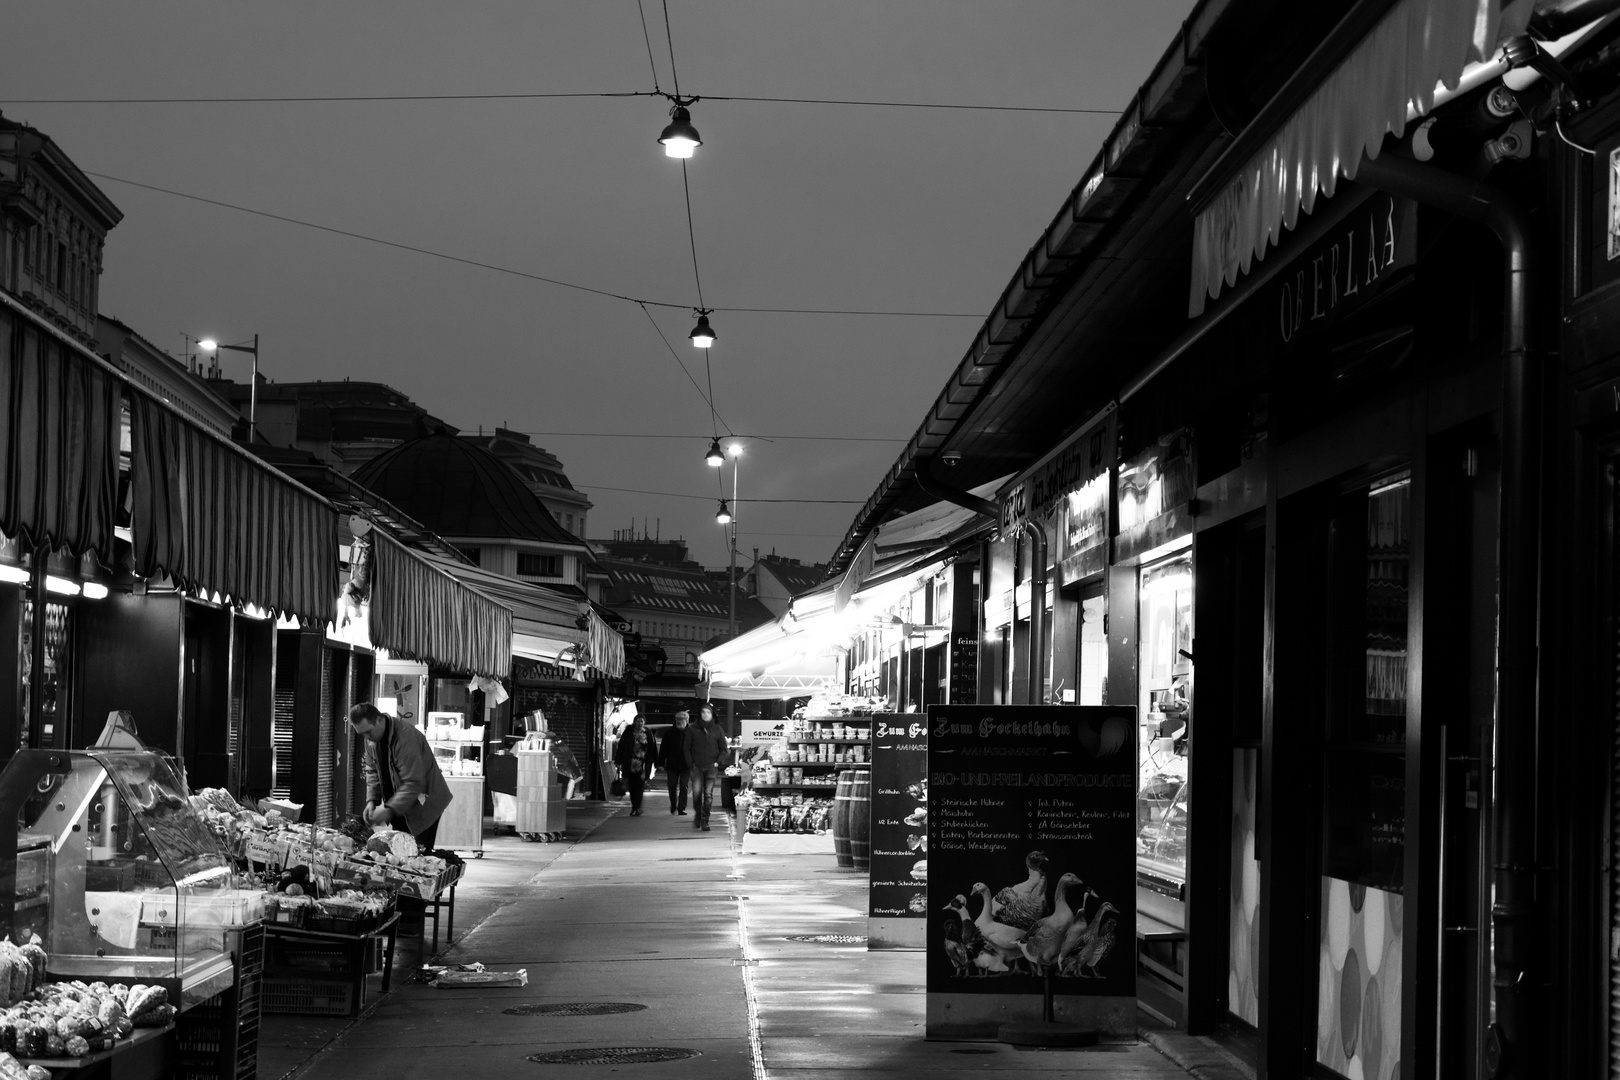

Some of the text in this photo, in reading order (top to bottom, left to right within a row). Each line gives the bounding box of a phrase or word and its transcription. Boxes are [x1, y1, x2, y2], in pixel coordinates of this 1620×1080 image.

[1280, 196, 1395, 342] OBERLAA
[610, 623, 626, 631] WC
[876, 722, 927, 738] Zum Go
[933, 716, 1070, 738] Zum Gockelhahn
[960, 747, 1048, 756] AM NASCHMARKT
[931, 772, 1132, 788] BIO- UND FREILANDPRODUKTE
[941, 797, 1006, 806] Steirische Hühner
[1053, 798, 1074, 807] Puten
[941, 808, 974, 817] Maishuhn
[1113, 810, 1130, 818] Filet
[1050, 820, 1090, 829] Gänseleber
[941, 829, 1020, 839] Enten, Barbarieenten
[1037, 831, 1094, 840] Straussensteak
[940, 840, 1007, 853] Gänse, Weidegans
